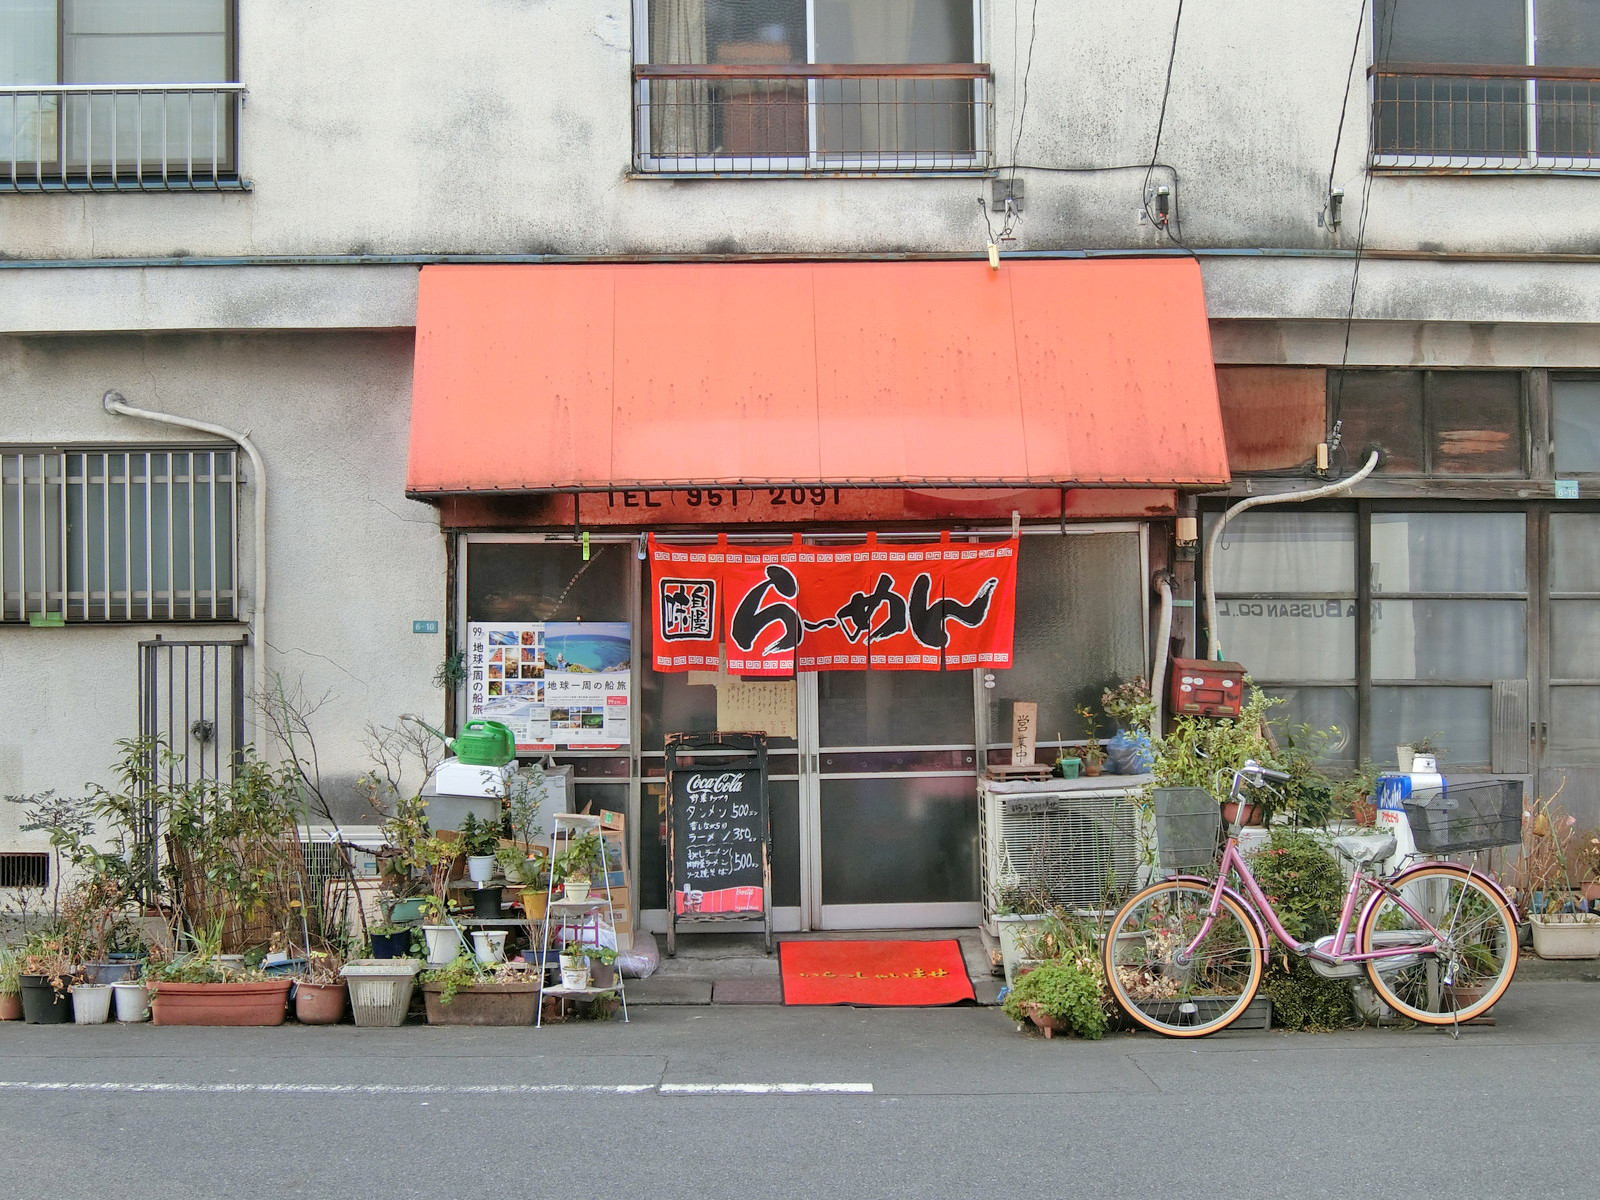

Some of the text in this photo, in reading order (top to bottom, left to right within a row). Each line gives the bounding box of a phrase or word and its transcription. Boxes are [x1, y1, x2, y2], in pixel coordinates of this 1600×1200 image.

[608, 489, 661, 507] TEL
[769, 488, 842, 505] 2091
[689, 585, 710, 632] 自慢
[731, 565, 999, 656] らーめん
[415, 623, 435, 631] 6-10
[472, 642, 484, 715] 地球一周の船旅
[547, 680, 627, 692] 地球一周の船旅
[1017, 714, 1030, 763] 営業中
[686, 772, 746, 794] Coca-Cola
[686, 804, 727, 820] タンメン
[688, 830, 731, 843] ラーメン
